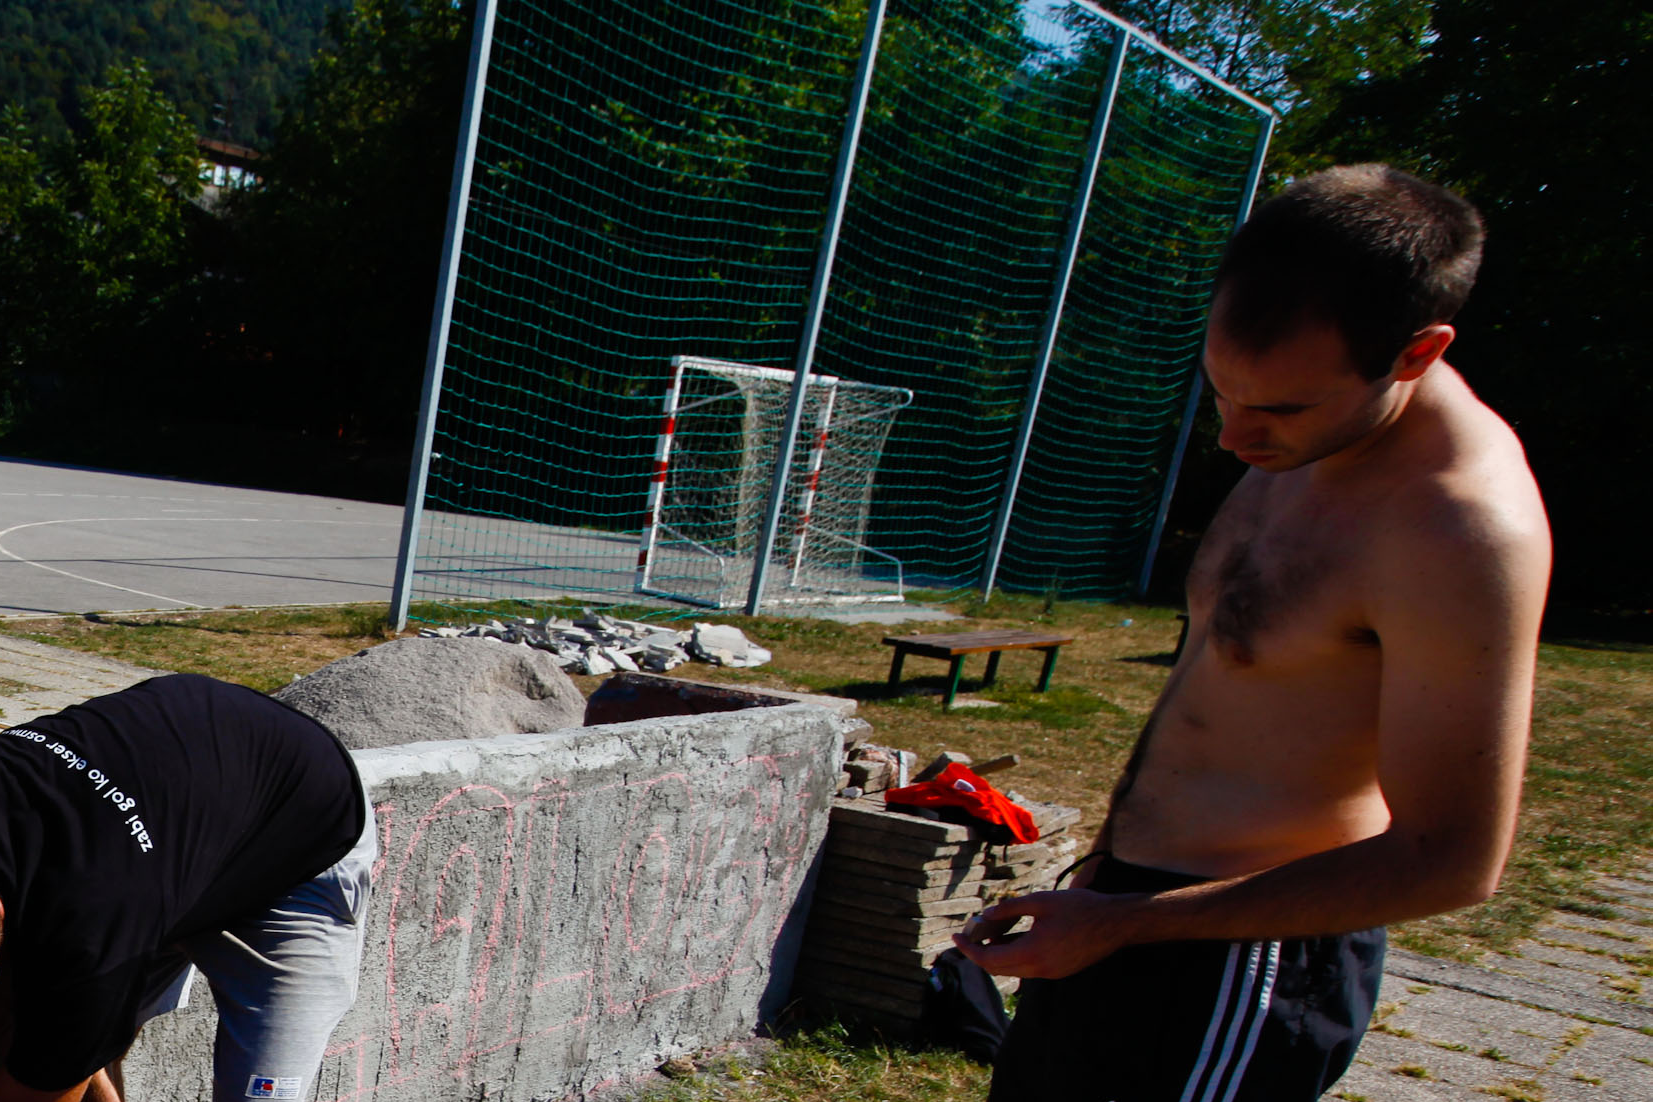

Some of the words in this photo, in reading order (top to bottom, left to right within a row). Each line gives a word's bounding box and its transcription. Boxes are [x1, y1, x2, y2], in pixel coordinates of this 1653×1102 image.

[45, 741, 88, 770] ekser
[87, 768, 110, 791] ko
[102, 786, 136, 812] gol
[124, 814, 154, 853] zabi
